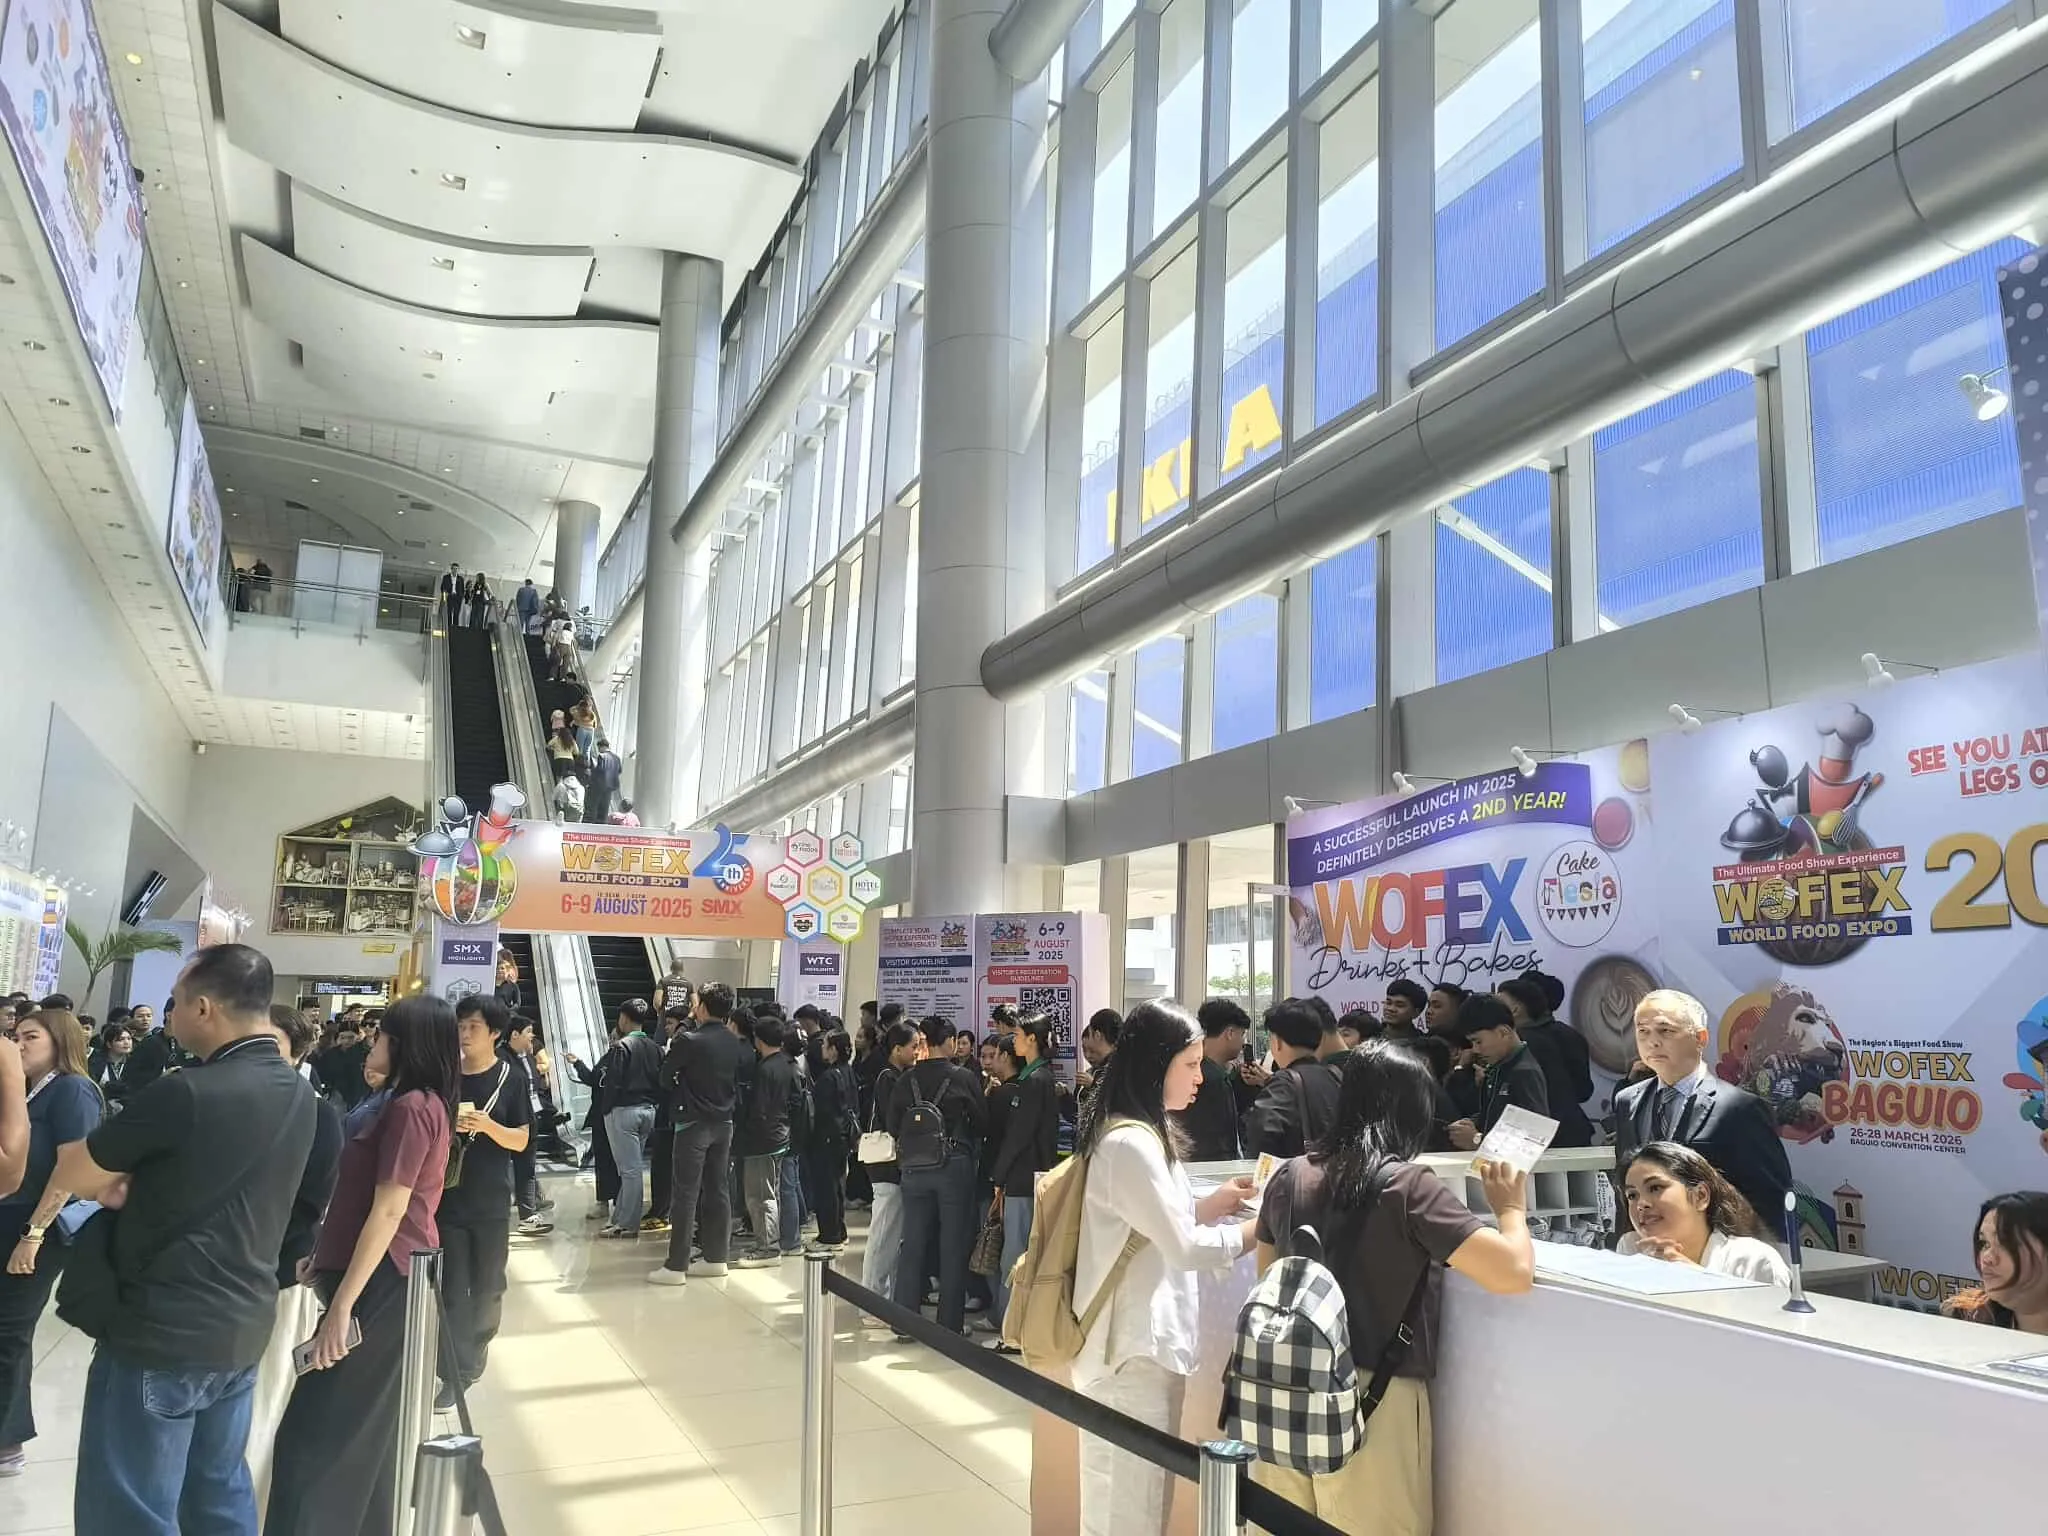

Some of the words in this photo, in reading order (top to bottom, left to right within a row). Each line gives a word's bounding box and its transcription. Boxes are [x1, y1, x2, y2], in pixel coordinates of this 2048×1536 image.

[1908, 745, 1946, 774] SEE
[1953, 734, 2010, 766] YOU
[2020, 727, 2048, 755] AT
[1960, 764, 2020, 796] LEGS
[1312, 841, 1321, 855] A
[1324, 812, 1400, 852] SUCCESSFUL
[1403, 788, 1459, 821] LAUNCH
[1463, 782, 1479, 800] IN
[1482, 773, 1517, 795] 2025
[1317, 840, 1384, 874] DEFINITELY
[1386, 813, 1455, 851] DESERVES
[1459, 809, 1469, 825] A
[1472, 797, 1507, 821] 2ND
[1512, 791, 1567, 812] YEAR!
[561, 843, 690, 875] WOFEX
[1557, 850, 1601, 877] Cake
[1717, 868, 1735, 878] The
[1737, 863, 1776, 876] Ultimate
[1778, 861, 1804, 872] Food
[1806, 856, 1835, 869] Show
[1838, 850, 1899, 867] Experience
[566, 872, 609, 883] WORLD
[612, 875, 645, 884] FOOD
[650, 877, 681, 887] EXPO
[561, 893, 592, 914] 6-9
[594, 897, 648, 915] AUGUST
[650, 897, 692, 918] 2025
[702, 899, 743, 915] SMX
[1313, 857, 1533, 953] WOFEX
[1713, 866, 1912, 923] WOFEX
[1038, 922, 1065, 937] 6-9
[1729, 927, 1787, 944] WORLD
[1792, 923, 1841, 940] FOOD
[1847, 919, 1898, 936] EXPO
[453, 944, 481, 954] SMX
[1034, 939, 1070, 949] AUGUST
[1038, 950, 1063, 960] 2025
[807, 957, 833, 965] WTC
[1307, 940, 1410, 990] Drinks
[1424, 936, 1543, 987] Bakes
[1341, 1001, 1380, 1014] WORLD
[1848, 1039, 1861, 1047] The
[1862, 1040, 1892, 1048] Region's
[1894, 1040, 1921, 1048] Biggest
[1922, 1040, 1941, 1048] Food
[1942, 1040, 1963, 1048] Show
[1848, 1050, 1975, 1081] WOFEX
[1822, 1079, 1982, 1134] BAGUIO
[1850, 1127, 1882, 1139] 26-28
[1884, 1130, 1929, 1143] MARCH
[1932, 1134, 1962, 1145] 2026
[1850, 1138, 1879, 1147] BAGUIO
[1881, 1140, 1932, 1151] CONVENTION
[1935, 1145, 1966, 1154] CENTER
[1877, 1266, 1984, 1302] WOF
